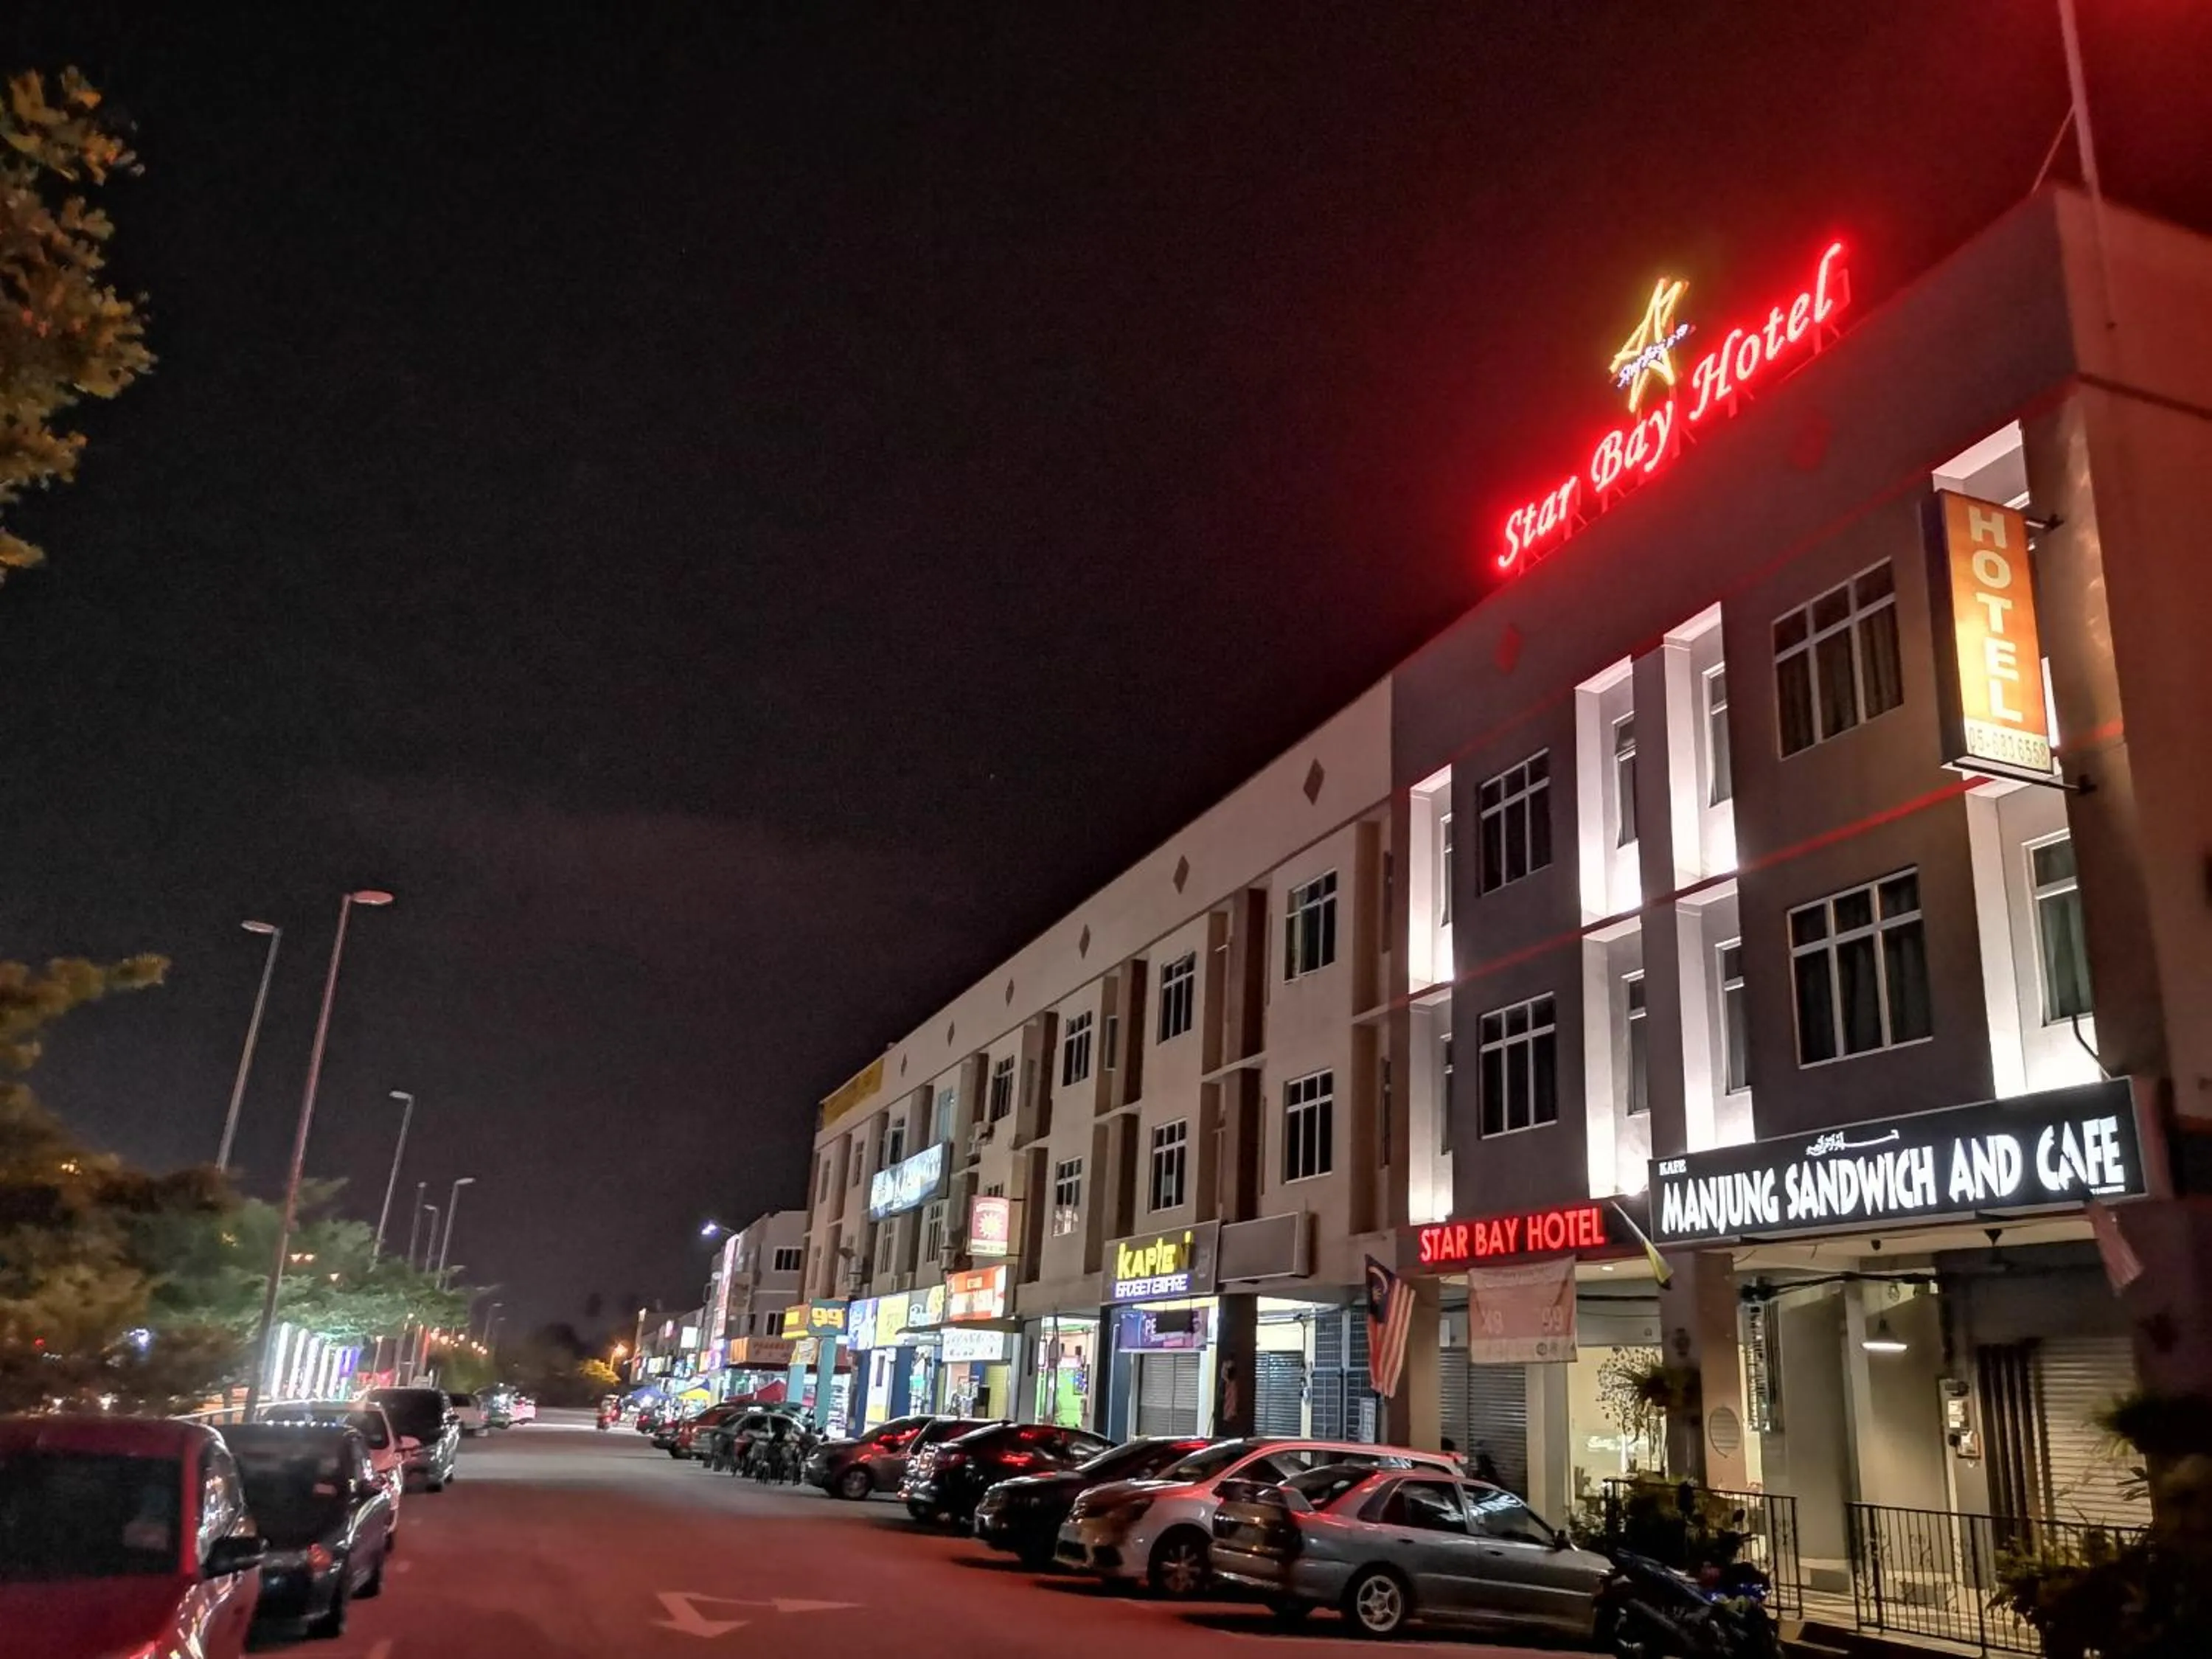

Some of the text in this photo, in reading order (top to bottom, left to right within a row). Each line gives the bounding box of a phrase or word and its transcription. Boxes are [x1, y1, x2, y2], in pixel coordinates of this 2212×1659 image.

[1498, 475, 1578, 568] Star
[1590, 400, 1674, 493] Bay
[1689, 242, 1842, 421] Hotel
[1967, 505, 2024, 724] HOTEL
[1420, 1207, 1605, 1262] STAR BAY HOTEL
[1661, 1115, 2125, 1235] MANJUNG SANDWICH AND CAFE
[812, 1307, 846, 1329] 99
